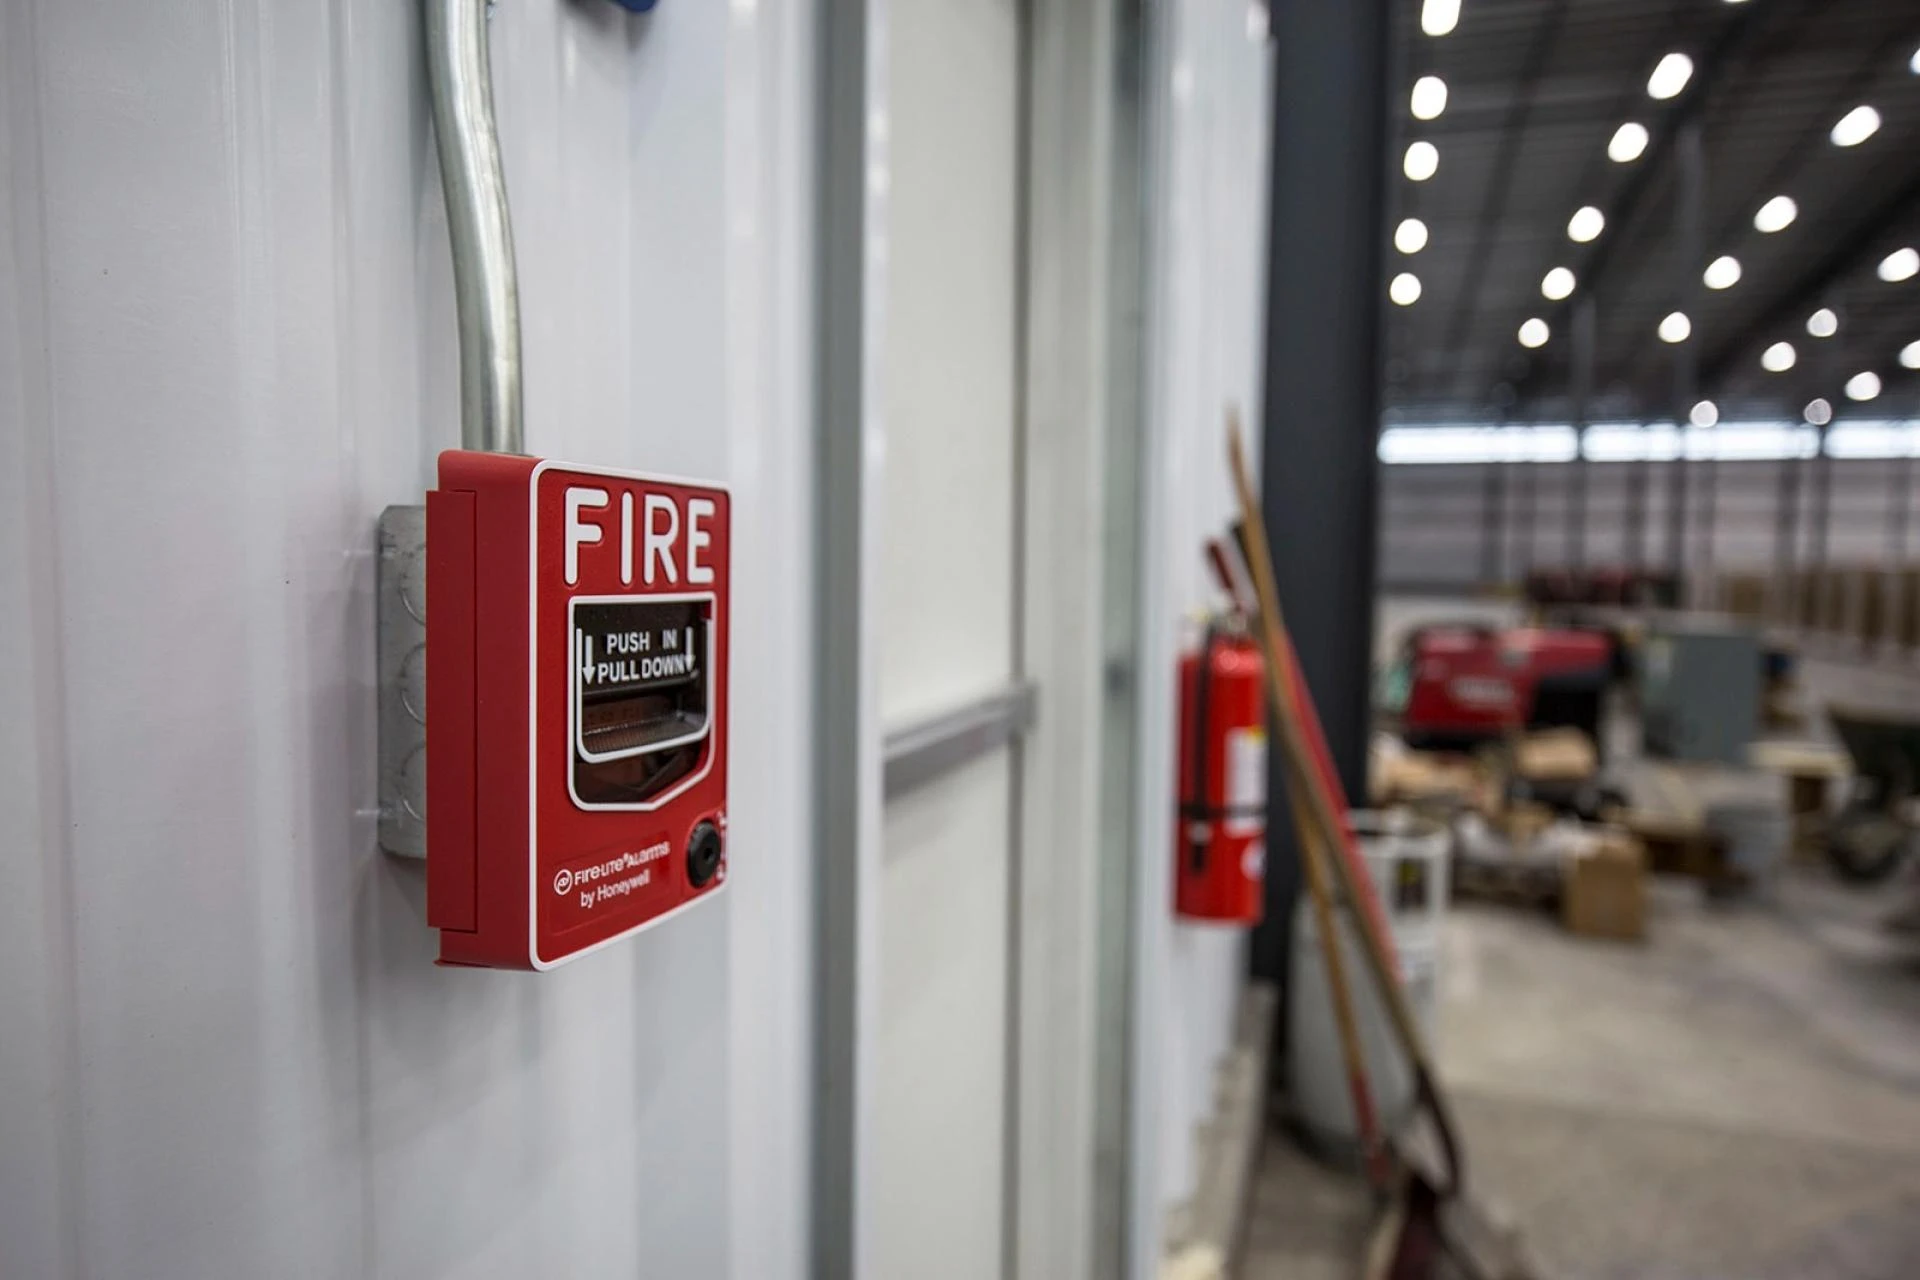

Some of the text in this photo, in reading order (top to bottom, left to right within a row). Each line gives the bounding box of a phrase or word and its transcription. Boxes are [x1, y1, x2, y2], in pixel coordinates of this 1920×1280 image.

[565, 486, 715, 585] FIRE
[606, 628, 677, 655] PUSH IN
[597, 653, 685, 684] PULL DOWN
[580, 869, 651, 909] by Honeywell
